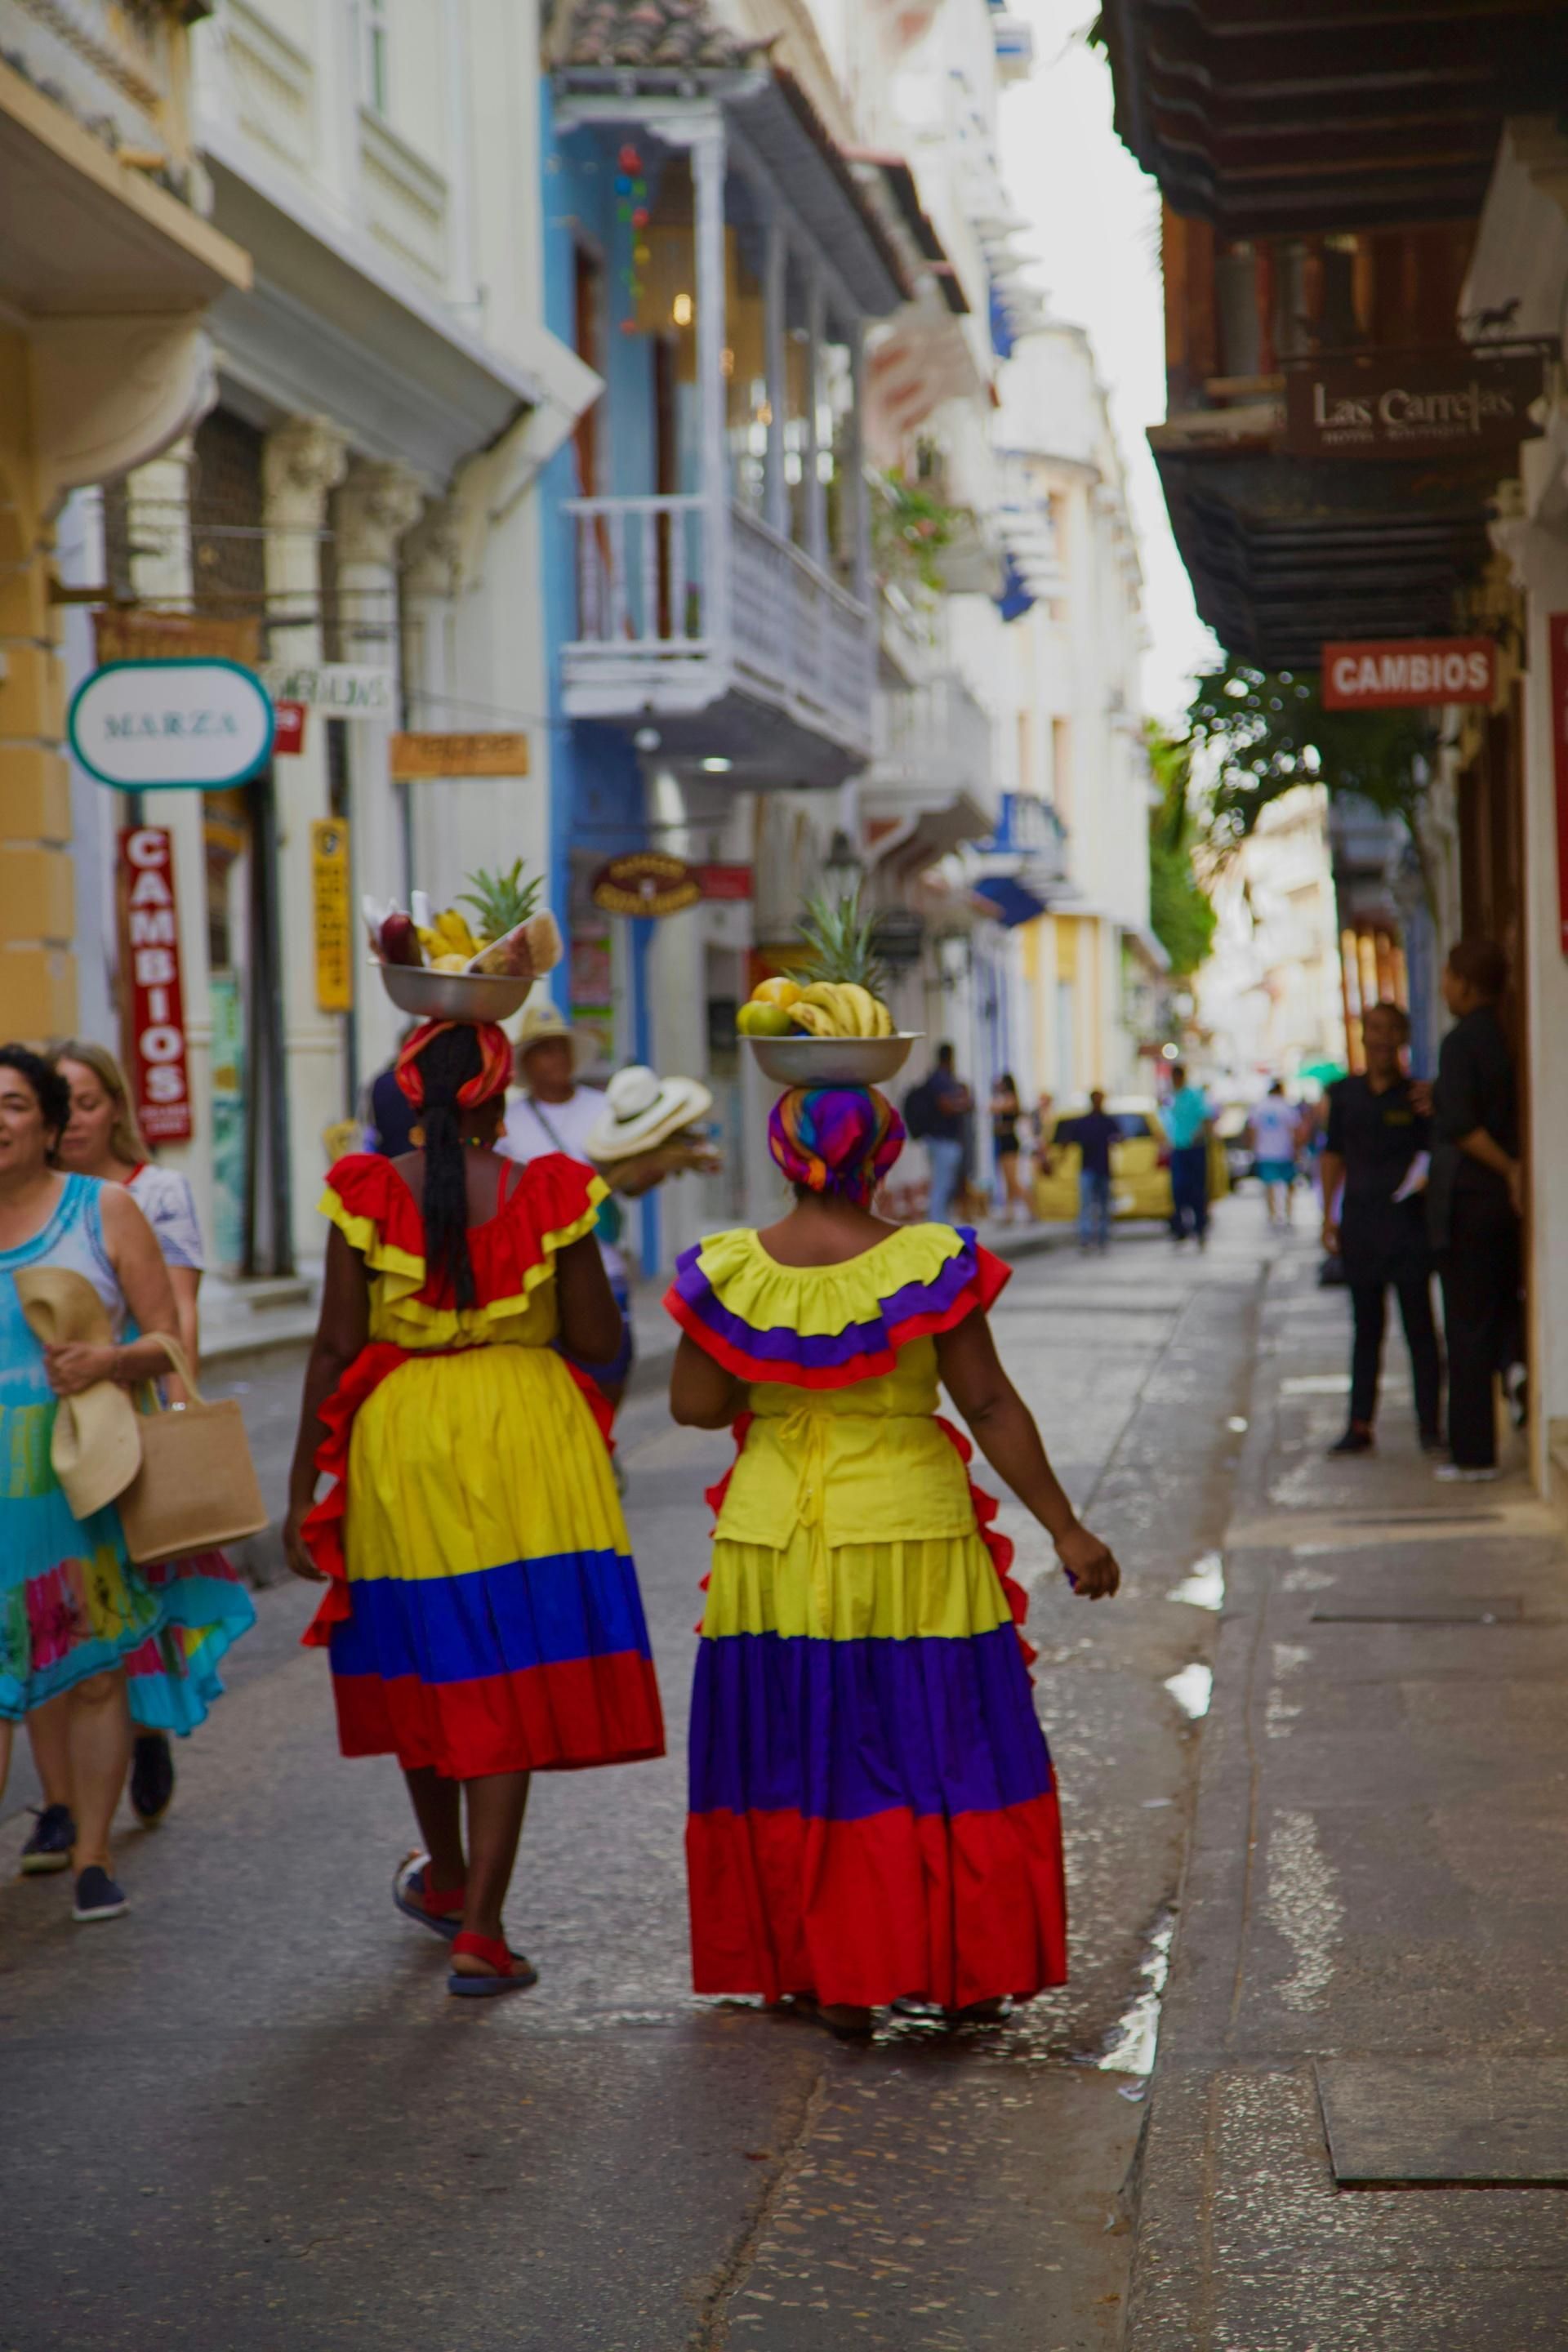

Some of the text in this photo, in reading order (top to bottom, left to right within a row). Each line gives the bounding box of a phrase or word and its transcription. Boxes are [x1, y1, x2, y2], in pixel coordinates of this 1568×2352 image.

[1313, 381, 1374, 429] Las
[1332, 651, 1490, 697] CAMBIOS
[103, 709, 239, 744] MARZA
[126, 828, 185, 1102] CAMBIOS
